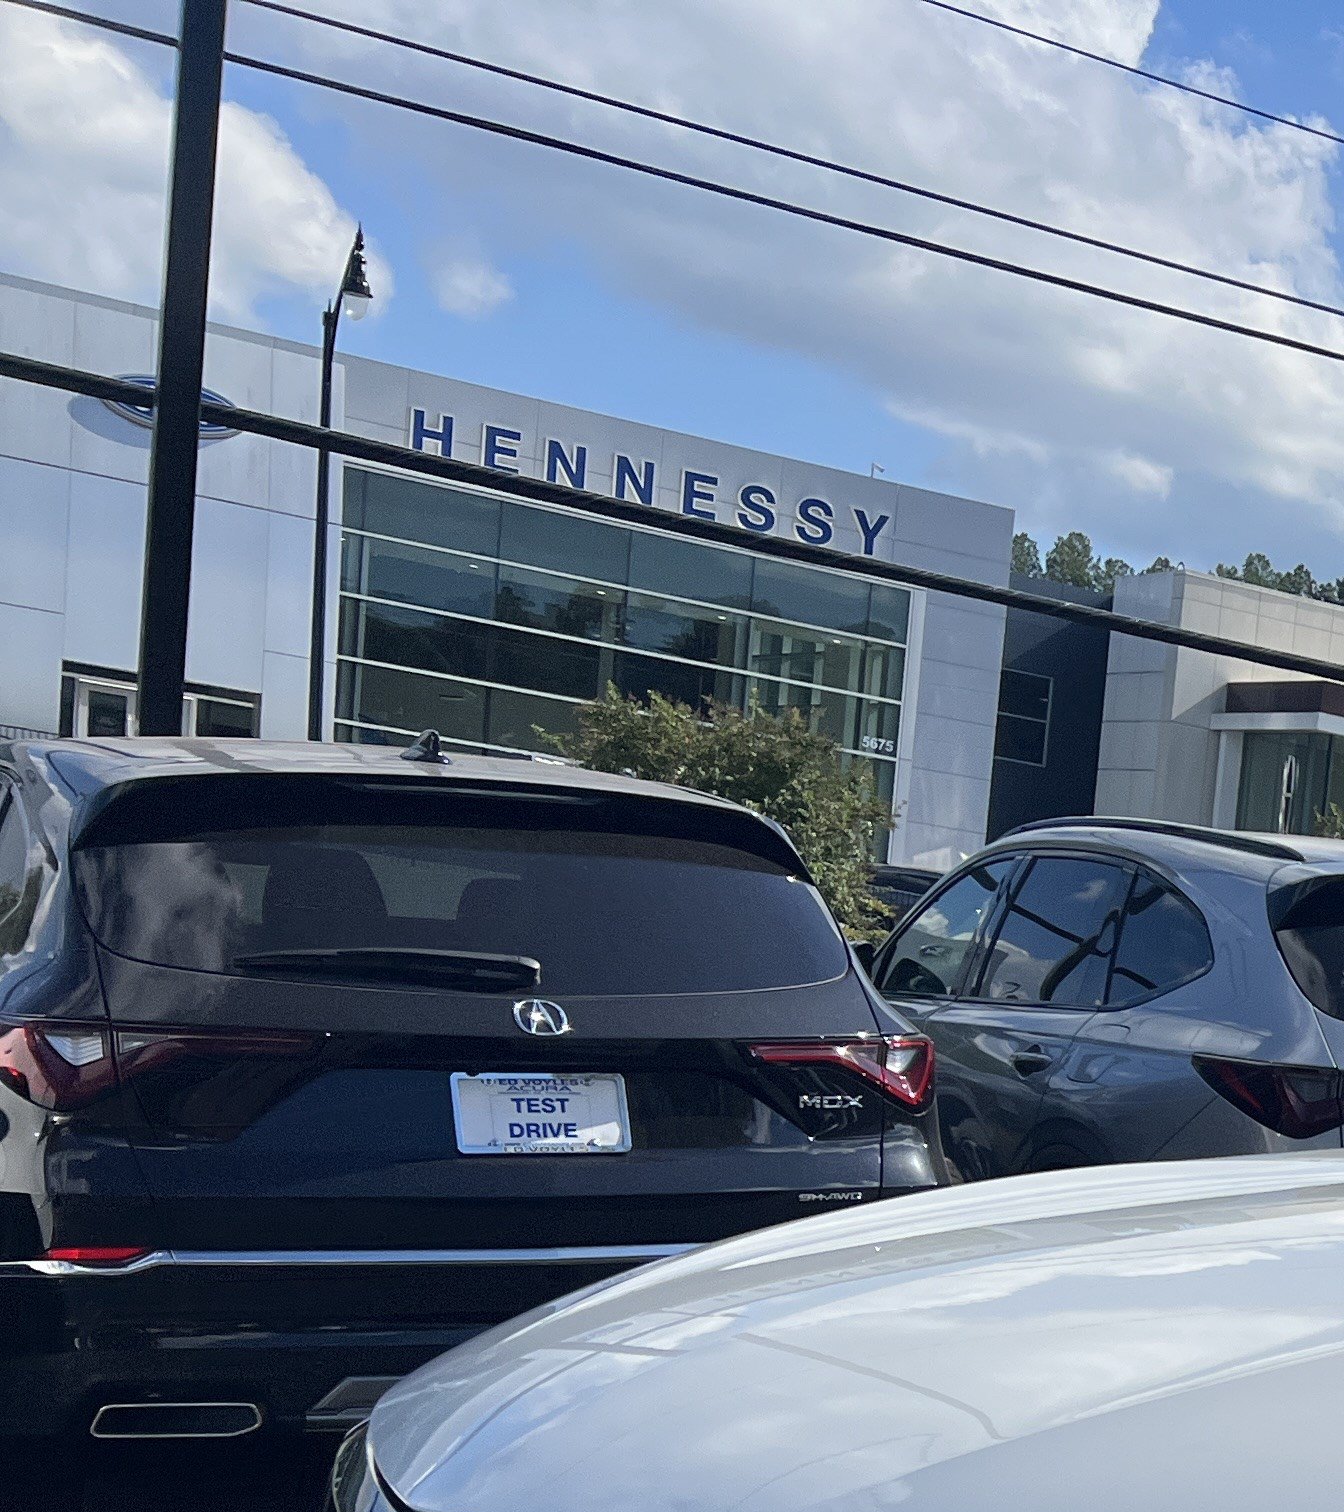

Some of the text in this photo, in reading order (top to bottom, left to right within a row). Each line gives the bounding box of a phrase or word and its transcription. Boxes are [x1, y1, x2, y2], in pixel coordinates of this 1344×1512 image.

[411, 407, 890, 556] HENNESSY
[862, 735, 894, 752] 5675
[511, 1098, 569, 1113] TEST
[799, 1095, 863, 1108] MDX
[509, 1123, 578, 1138] DRIVE
